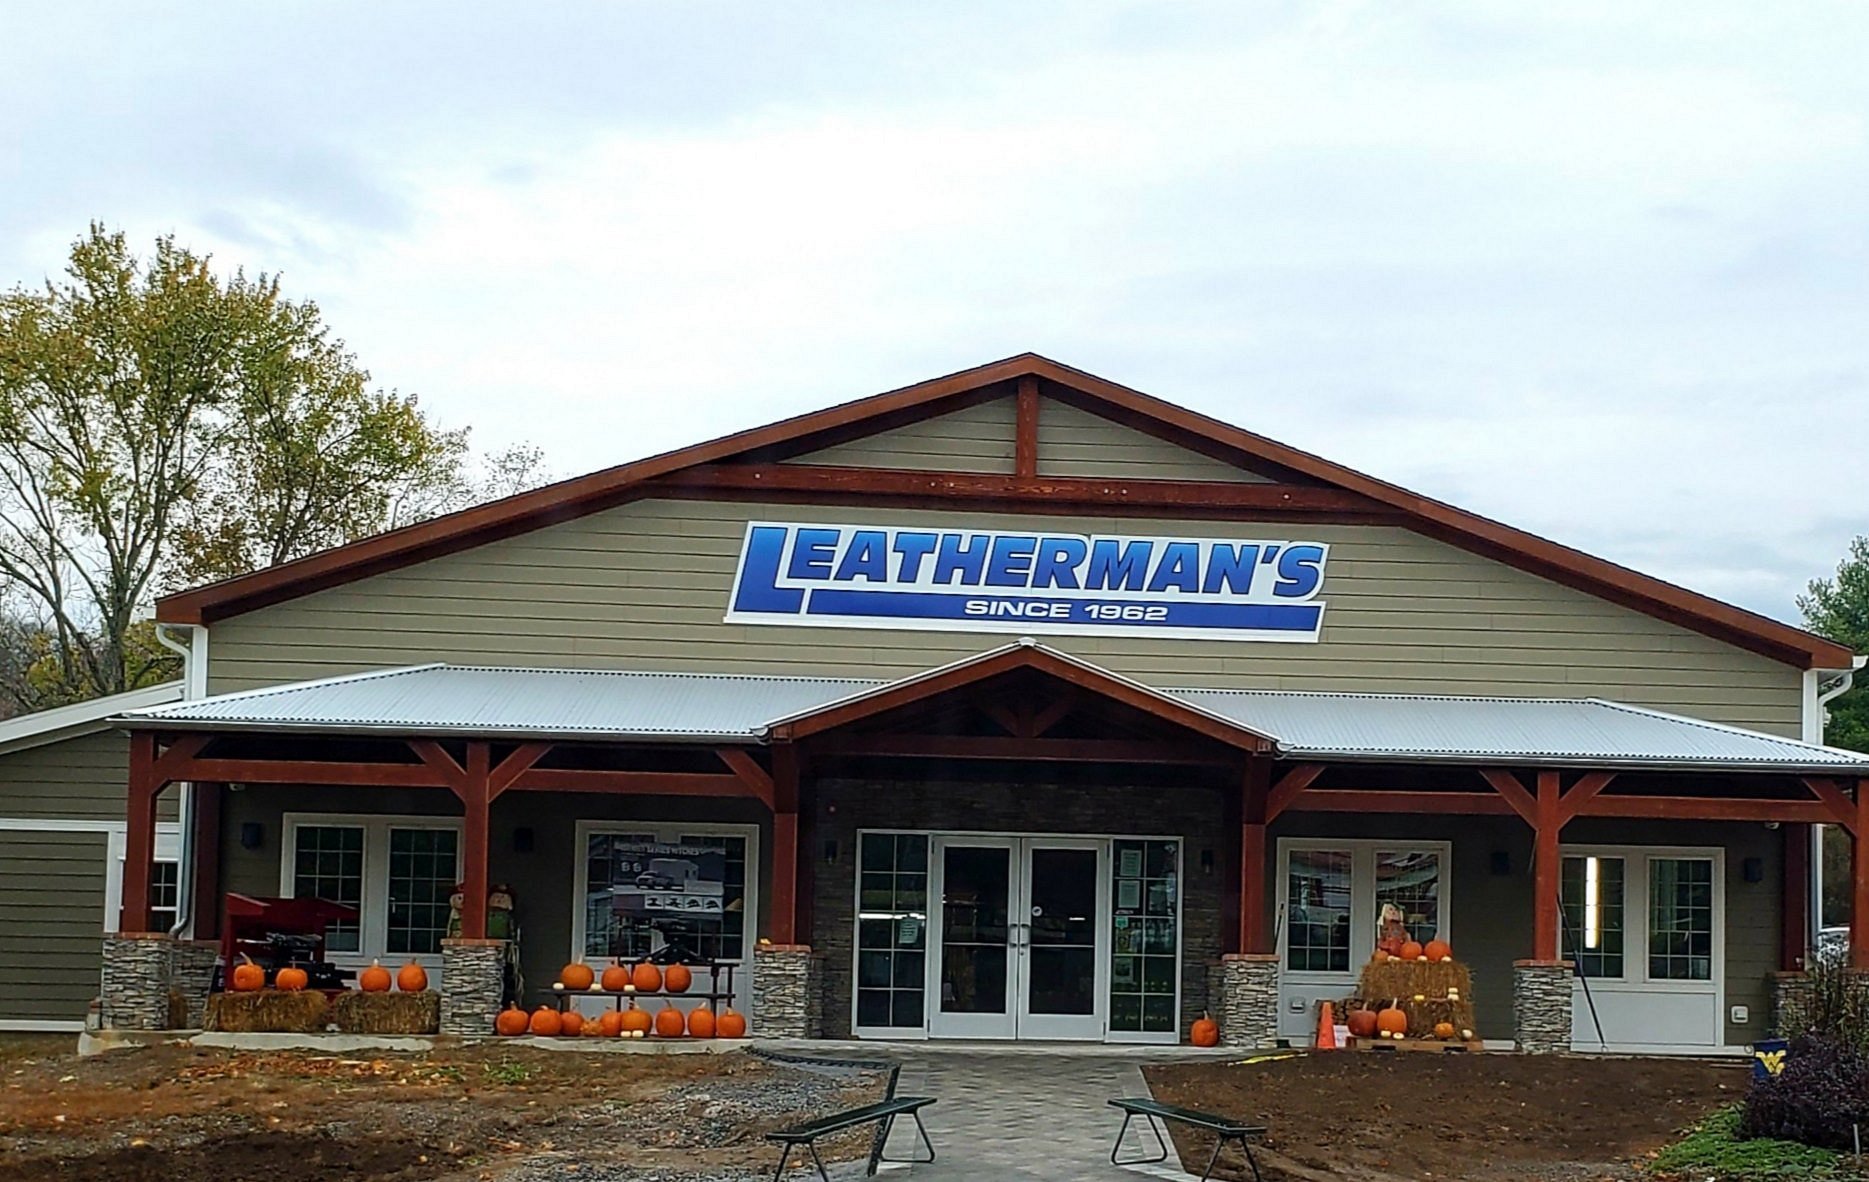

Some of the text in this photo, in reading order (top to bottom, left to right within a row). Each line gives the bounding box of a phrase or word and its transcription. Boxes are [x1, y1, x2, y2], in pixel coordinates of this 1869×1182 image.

[733, 526, 1324, 614] LEATHERMAN'S
[964, 600, 1169, 621] SINCE 1962
